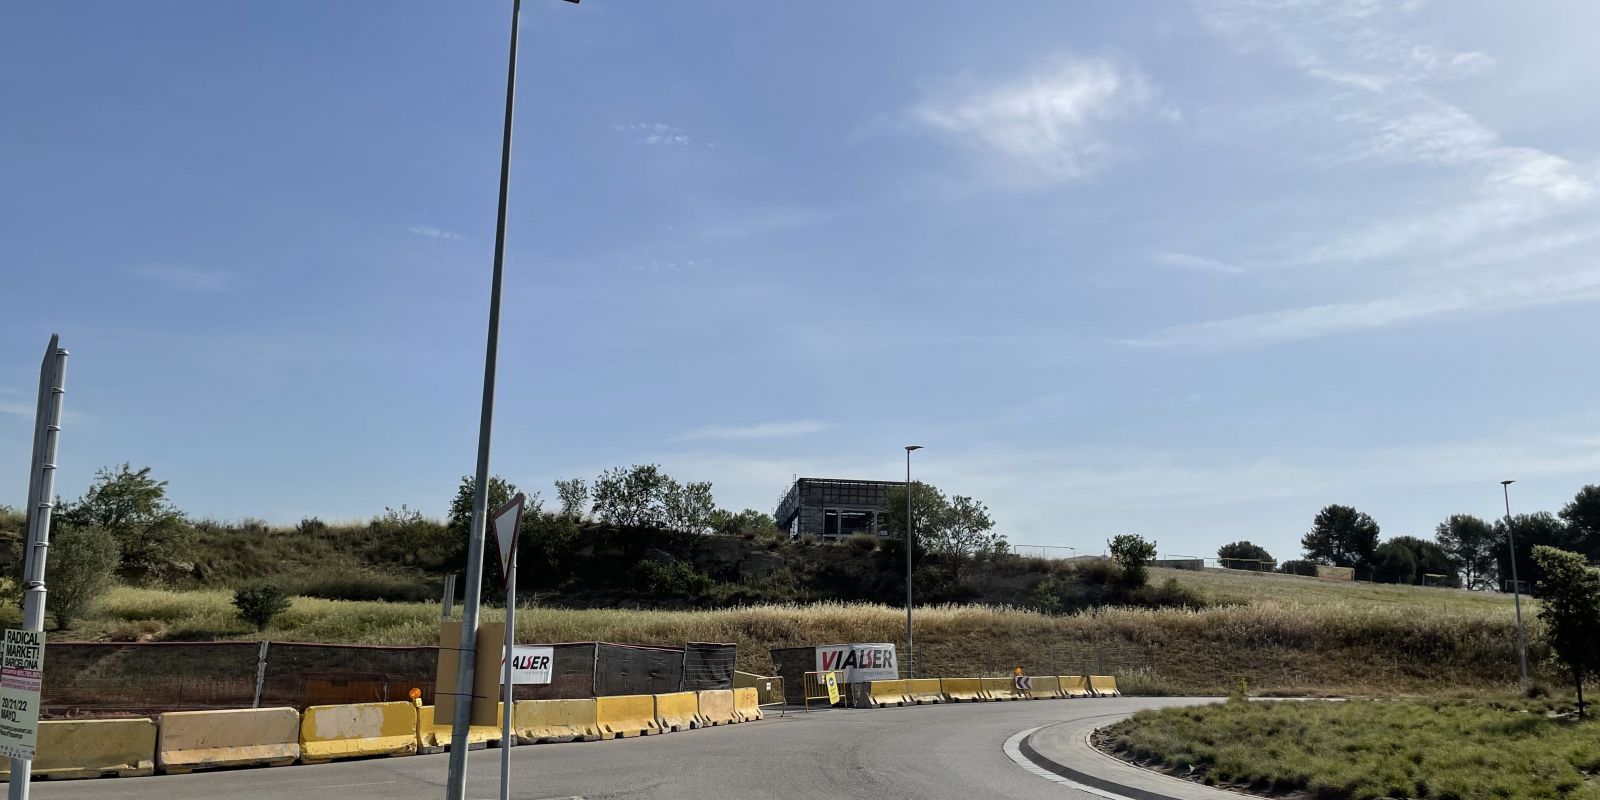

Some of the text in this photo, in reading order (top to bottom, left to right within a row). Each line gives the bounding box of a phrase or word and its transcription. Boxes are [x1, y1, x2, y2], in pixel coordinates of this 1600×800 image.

[7, 630, 40, 646] RADICAL
[6, 644, 40, 660] MARKET!
[4, 656, 39, 670] BARCELONA
[502, 655, 550, 670] ALSER
[822, 649, 893, 671] VIALSER
[2, 697, 27, 711] 20/21/22
[1, 709, 17, 722] MAYO
